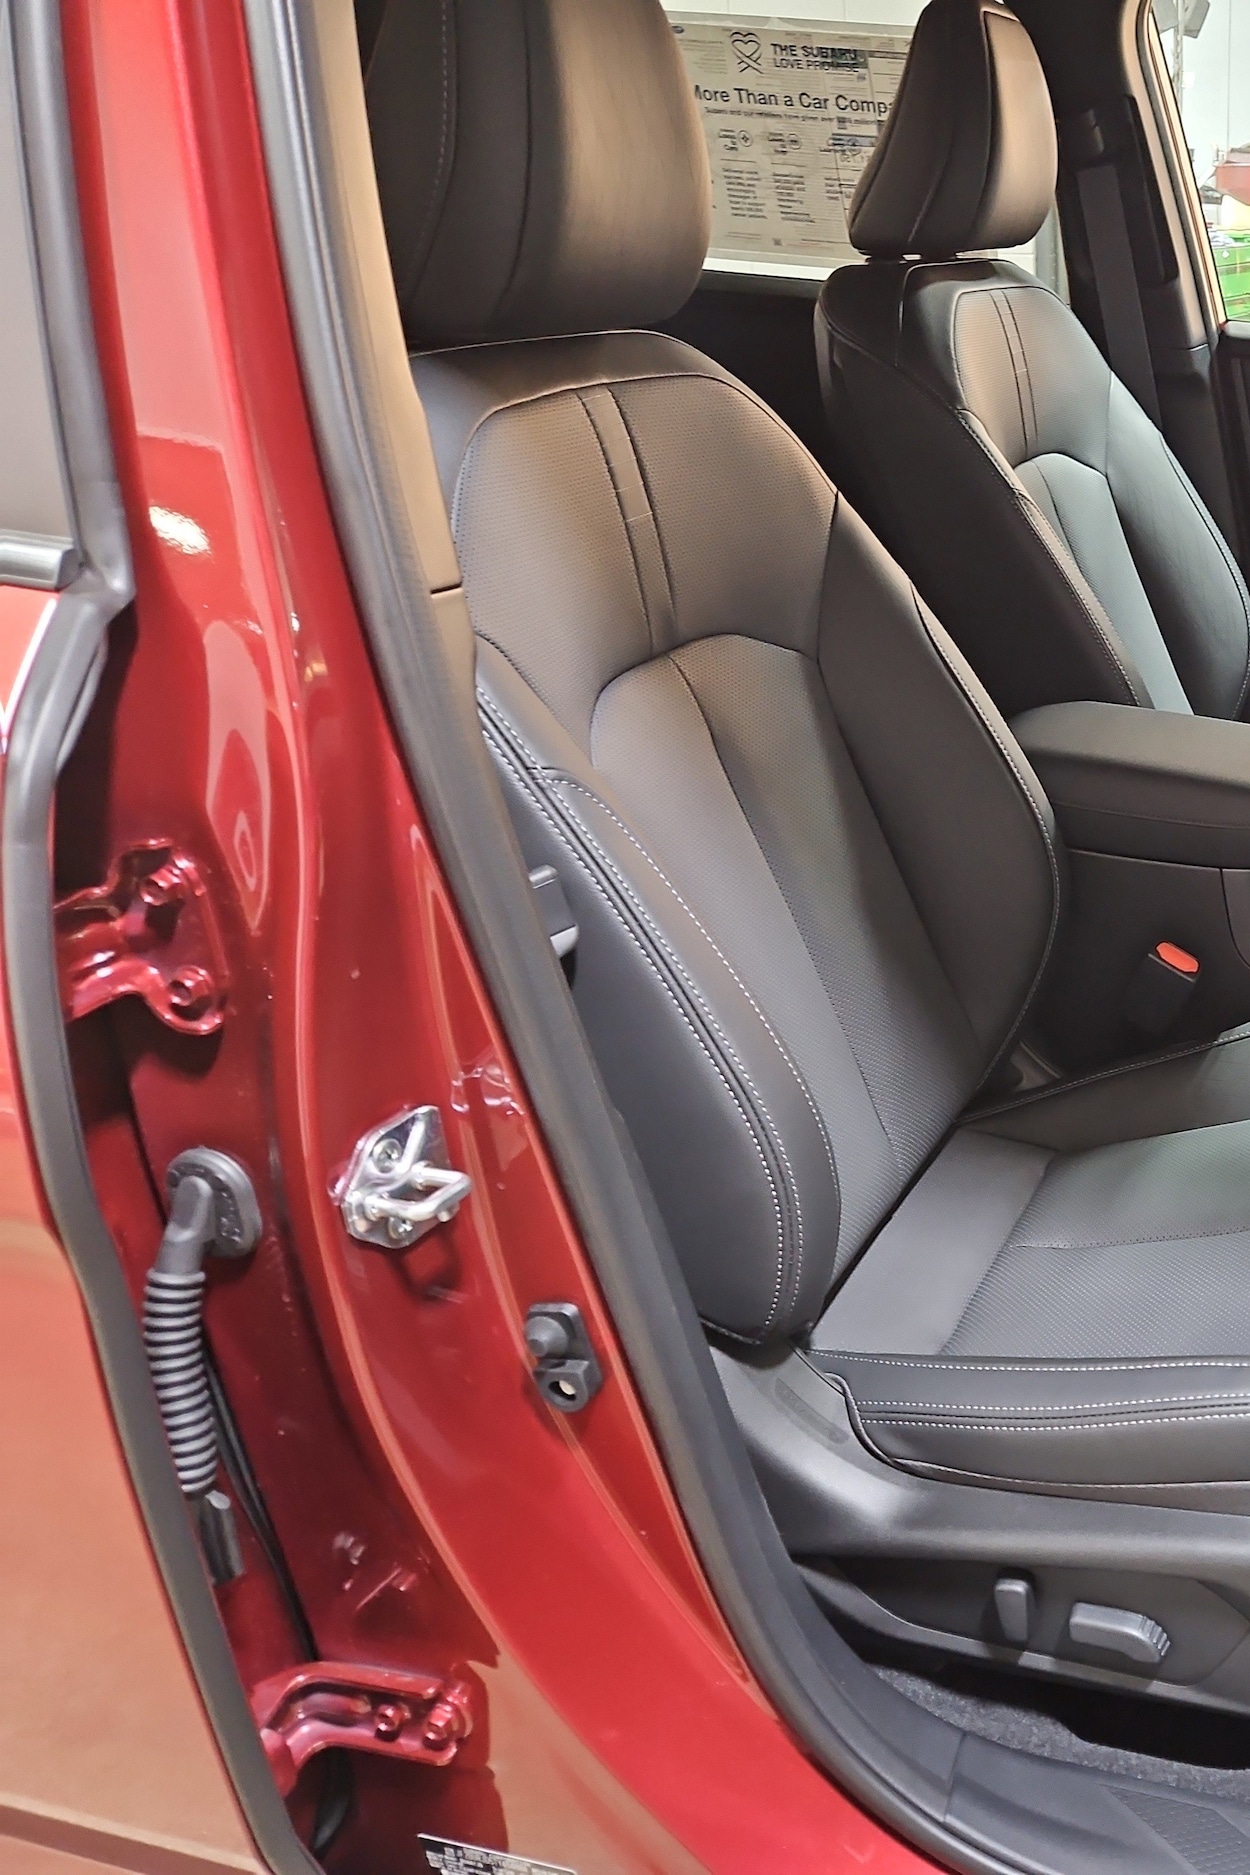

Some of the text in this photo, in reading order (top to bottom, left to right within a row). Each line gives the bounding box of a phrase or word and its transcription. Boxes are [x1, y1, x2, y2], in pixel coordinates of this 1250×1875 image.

[770, 43, 797, 57] THE
[773, 58, 804, 69] LOVE
[733, 87, 779, 106] Than
[783, 94, 795, 107] a
[798, 92, 829, 110] Car
